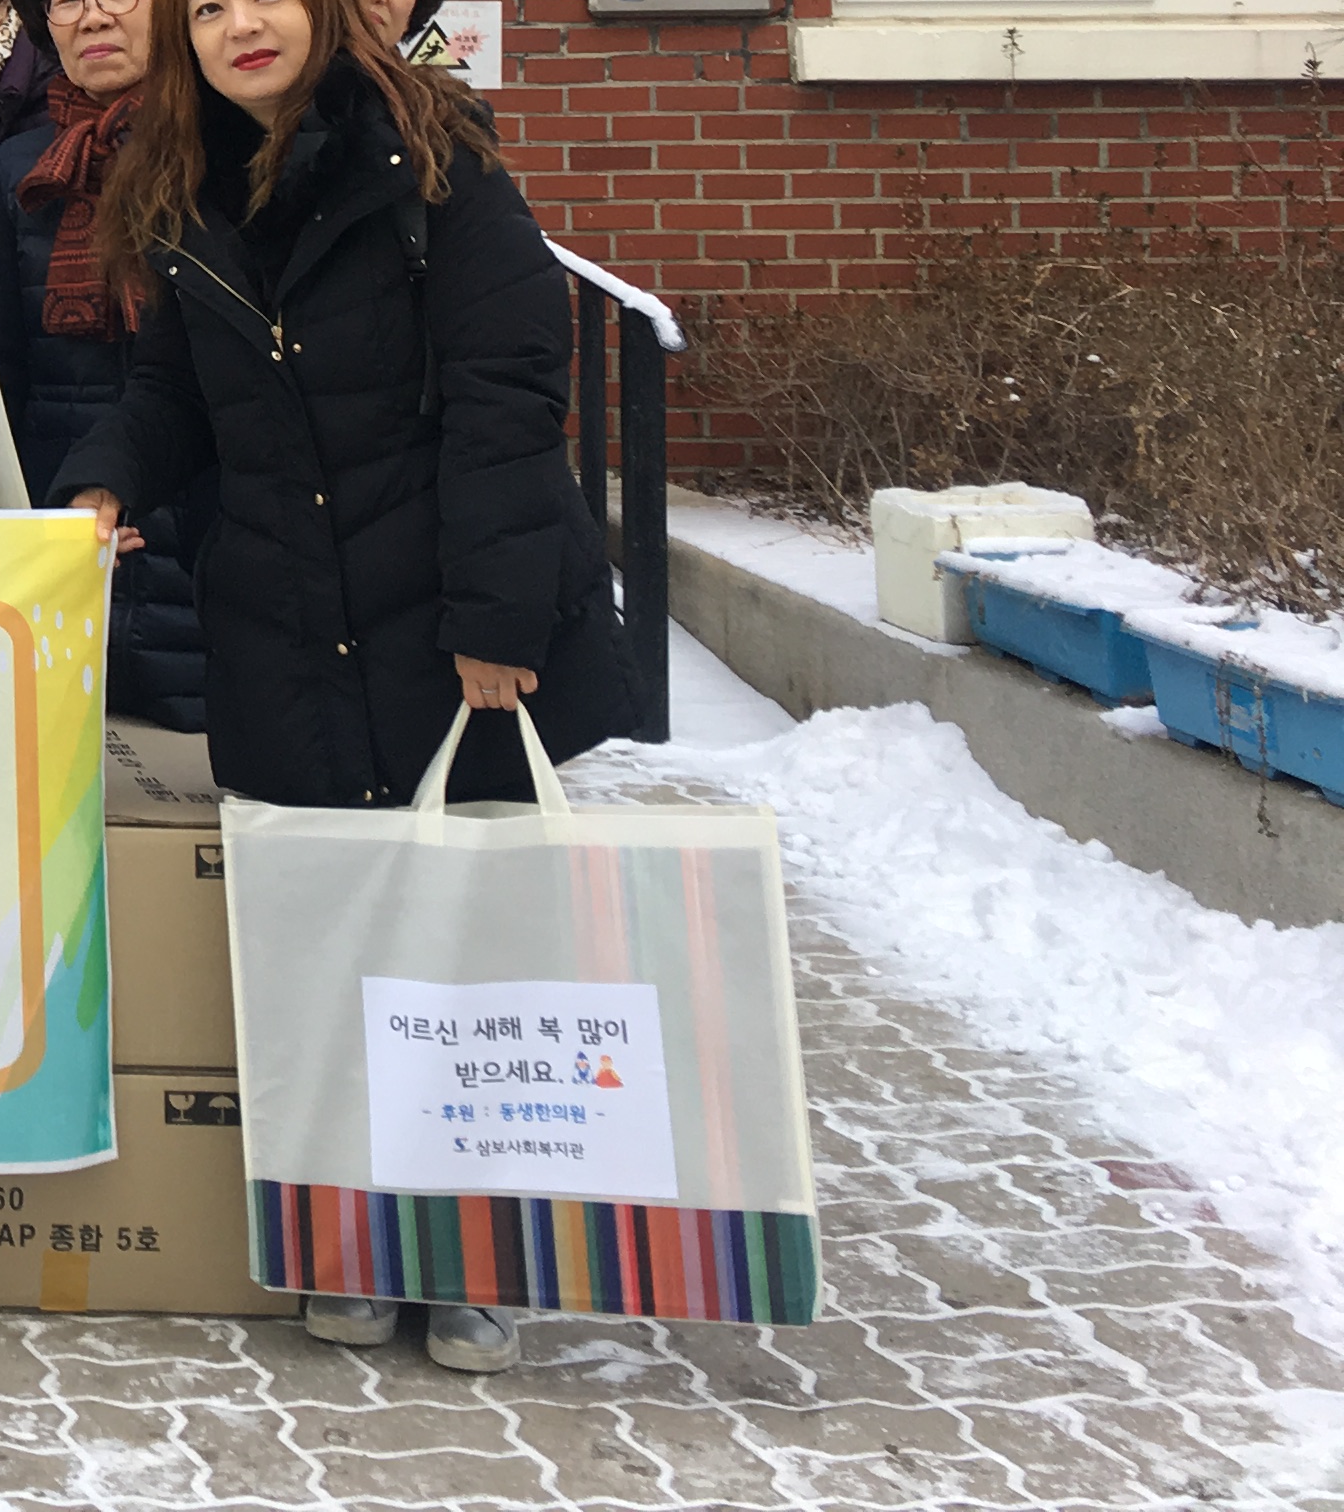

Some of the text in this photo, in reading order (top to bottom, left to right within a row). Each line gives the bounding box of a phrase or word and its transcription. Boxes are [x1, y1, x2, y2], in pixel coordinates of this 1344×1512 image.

[390, 1014, 629, 1046] 어르신 새해 복 많이
[455, 1061, 564, 1088] 받으세요.
[441, 1104, 475, 1123] 후원
[499, 1103, 587, 1124] 동생한의원
[476, 1139, 585, 1160] 삼보사회복지관
[50, 1222, 103, 1253] 종합
[117, 1224, 161, 1252] 5호
